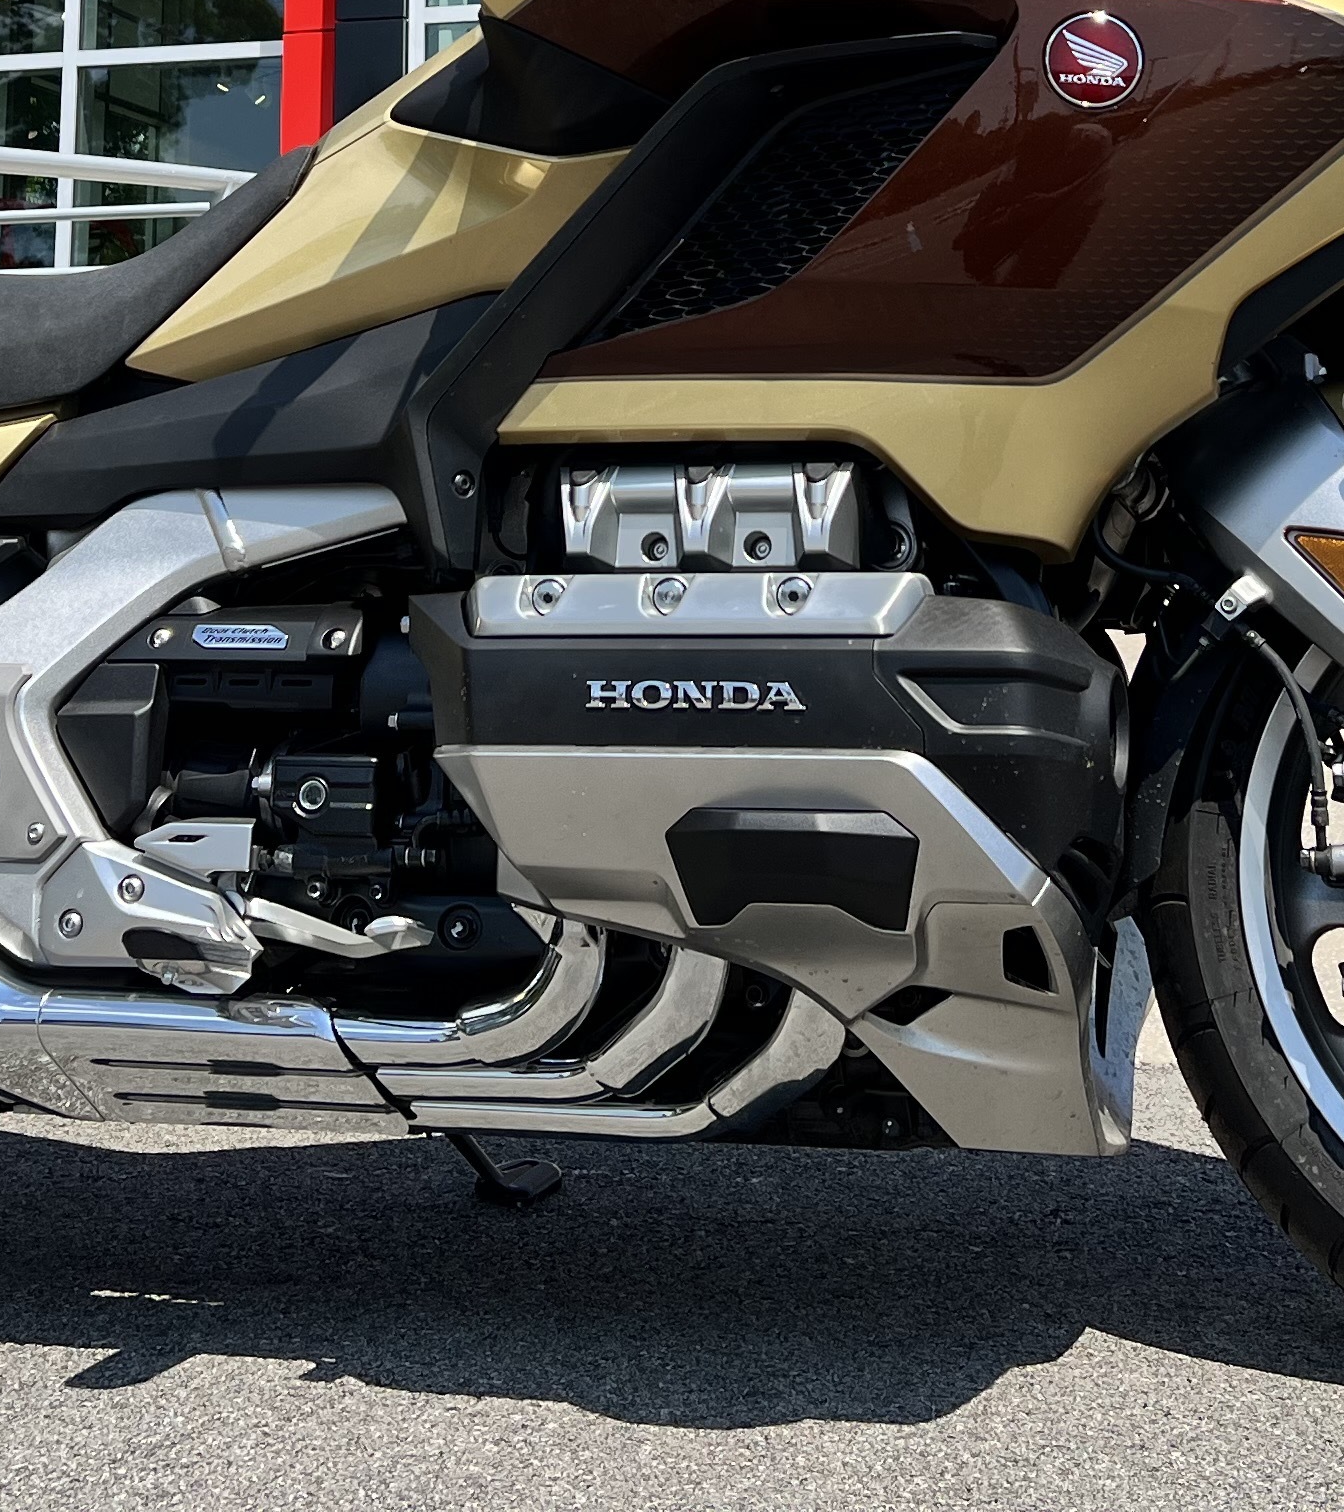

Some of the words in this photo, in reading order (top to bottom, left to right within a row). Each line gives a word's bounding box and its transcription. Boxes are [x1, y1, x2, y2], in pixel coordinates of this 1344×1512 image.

[1059, 73, 1126, 88] HONDA
[203, 634, 283, 645] Transmission
[585, 679, 807, 712] HONDA
